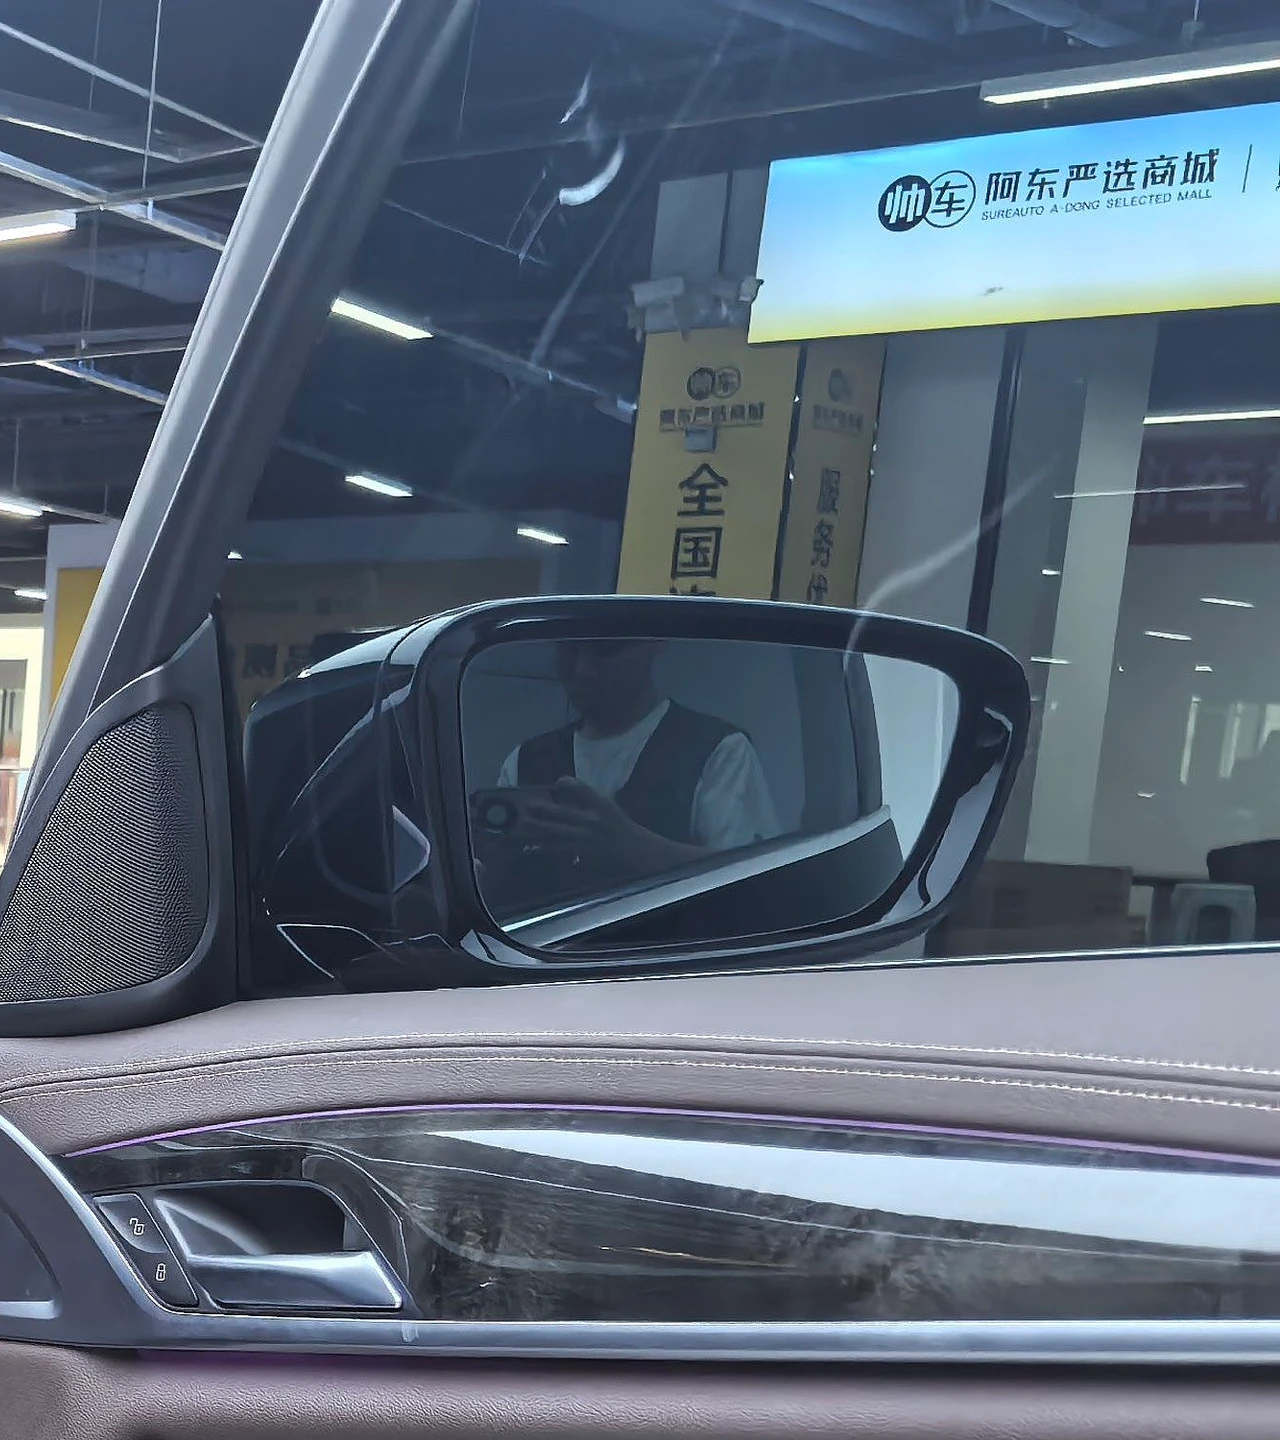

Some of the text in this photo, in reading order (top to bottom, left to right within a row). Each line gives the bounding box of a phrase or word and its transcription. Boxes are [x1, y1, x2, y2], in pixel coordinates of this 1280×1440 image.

[985, 148, 1220, 205] 阿东严选商城
[1106, 191, 1173, 210] SELECTED
[669, 463, 728, 595] 全国
